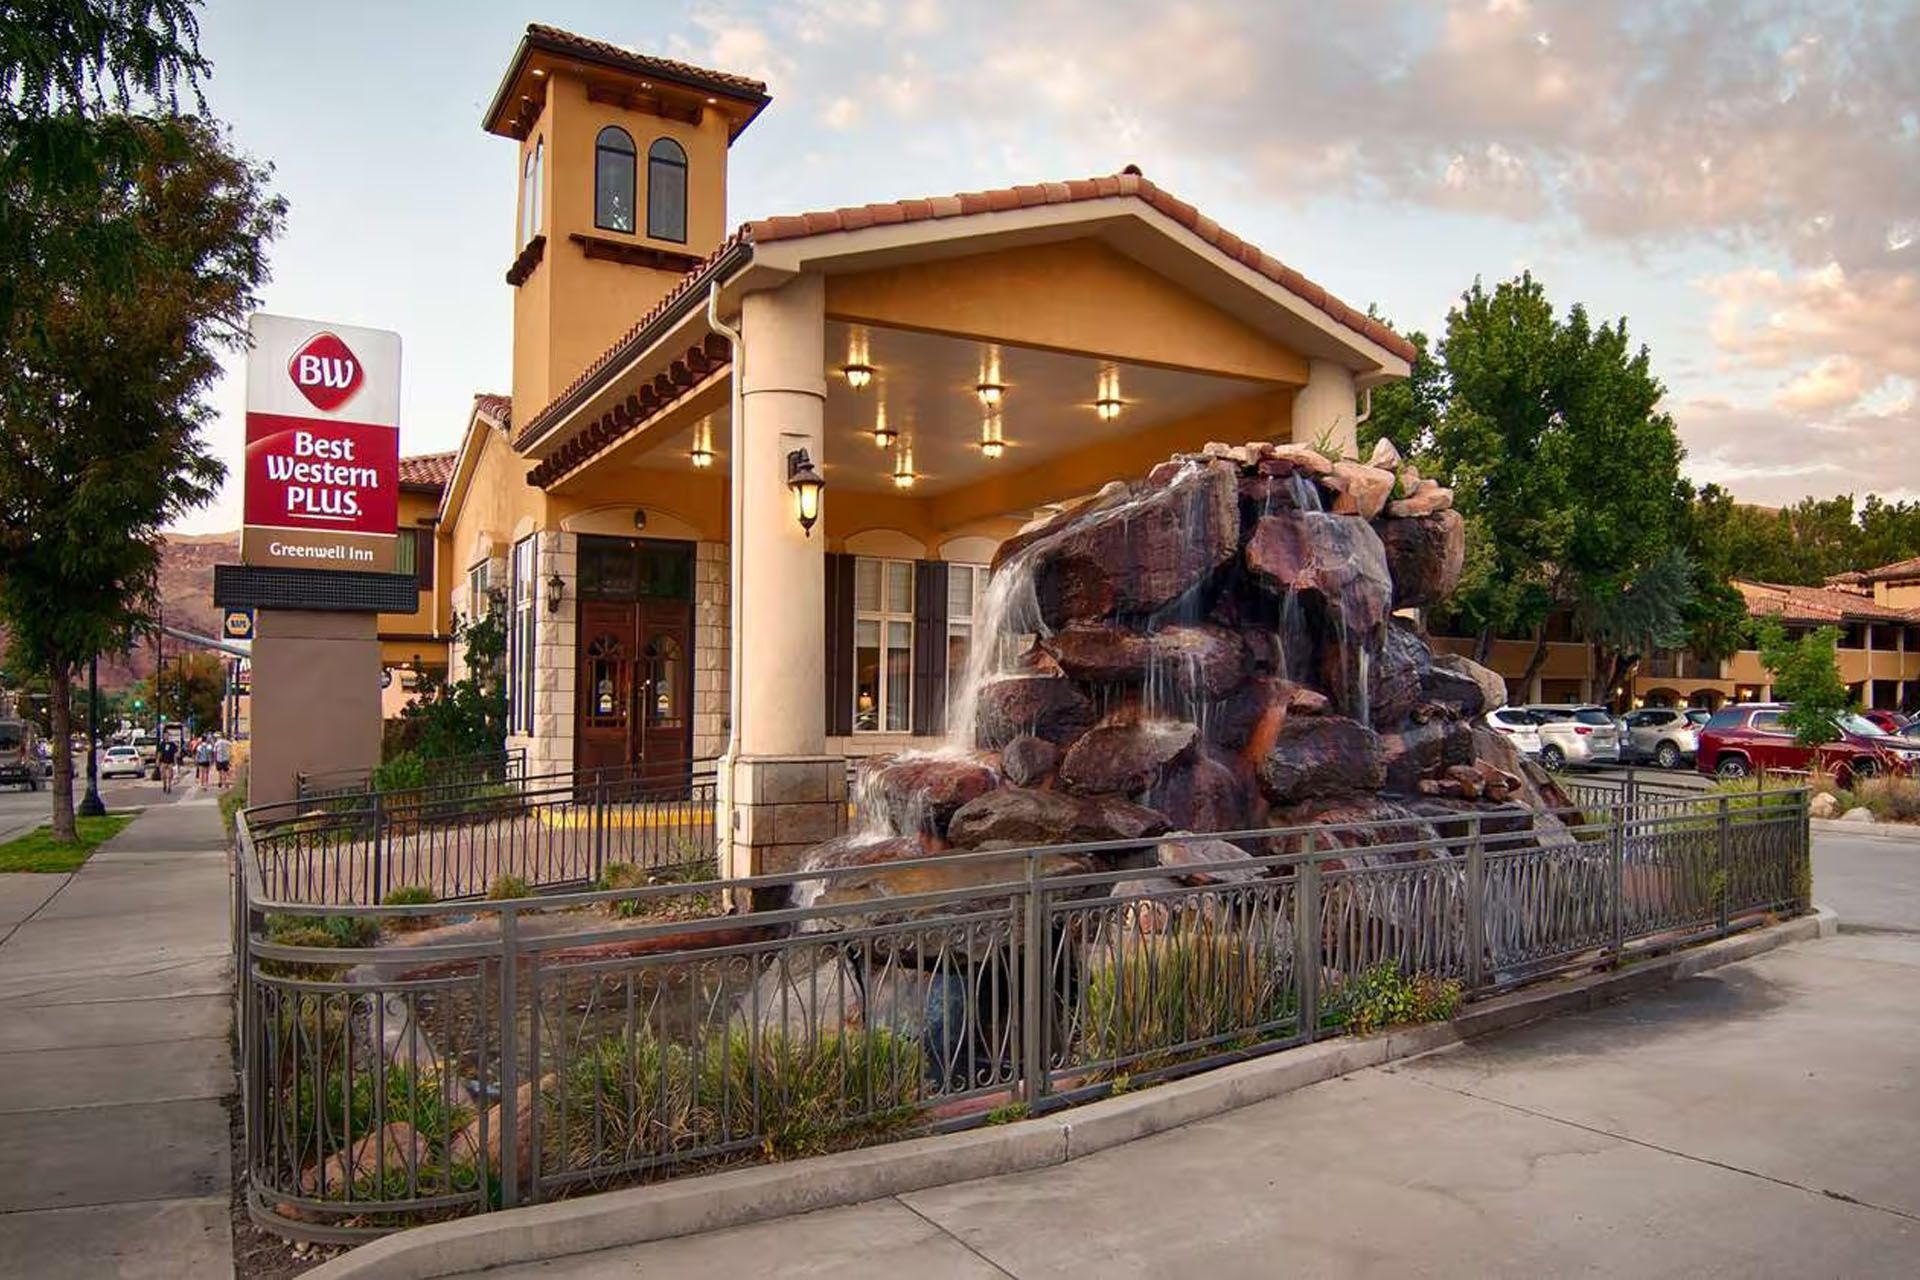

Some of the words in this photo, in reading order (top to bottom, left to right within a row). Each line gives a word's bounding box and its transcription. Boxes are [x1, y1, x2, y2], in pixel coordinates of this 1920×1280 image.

[300, 354, 354, 389] BW
[295, 431, 355, 461] Best
[266, 454, 378, 488] Western
[270, 542, 345, 559] Greenwell
[349, 547, 374, 561] Inn
